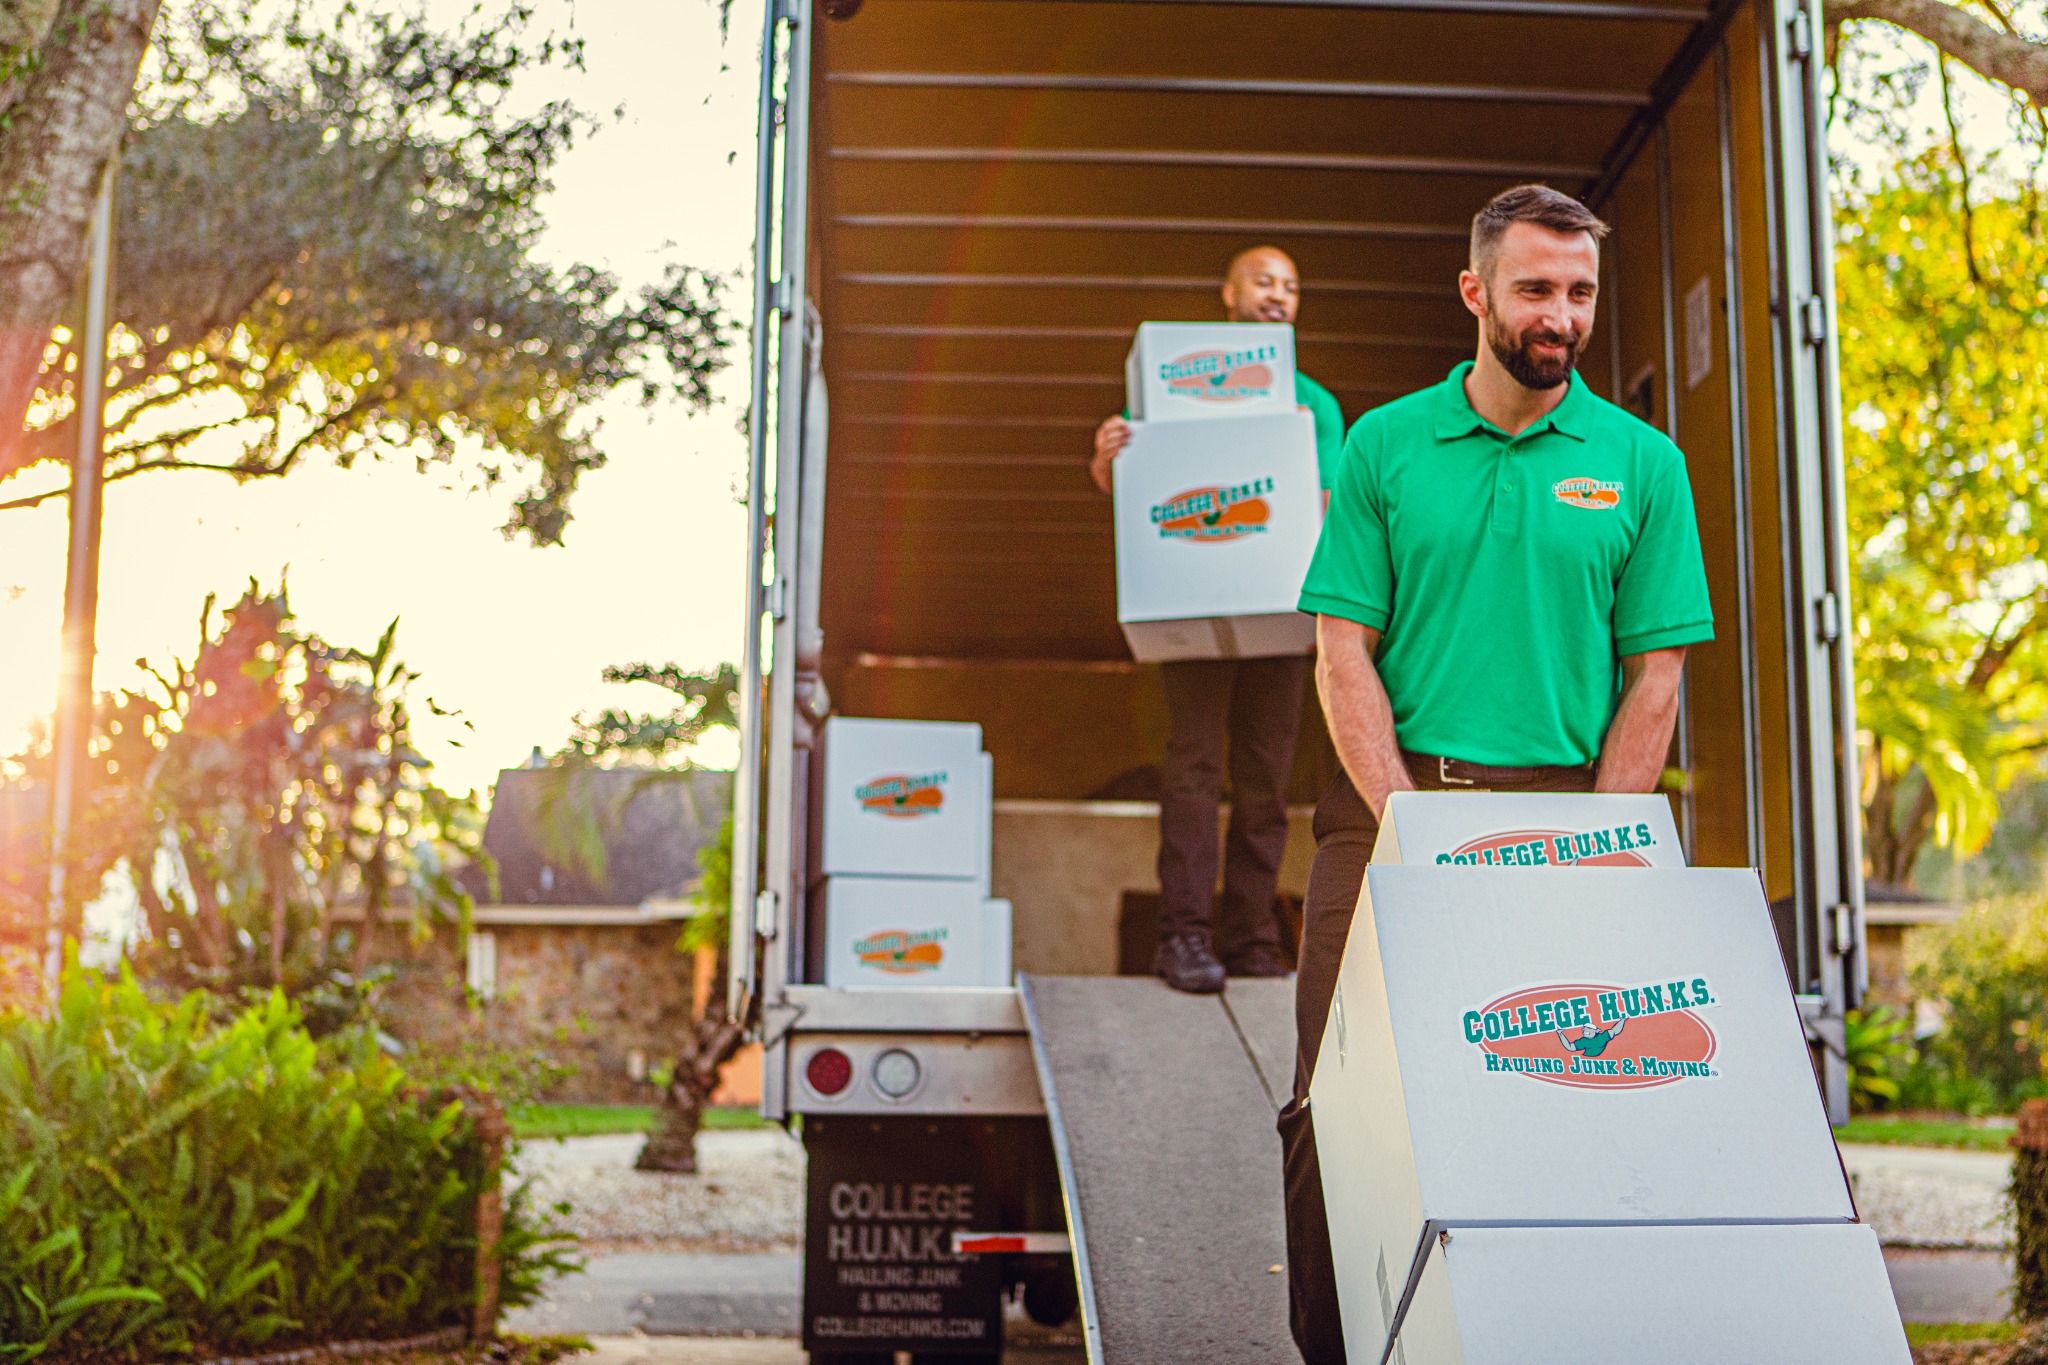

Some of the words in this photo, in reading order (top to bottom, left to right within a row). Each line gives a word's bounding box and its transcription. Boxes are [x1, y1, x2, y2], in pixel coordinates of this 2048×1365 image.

[1554, 823, 1657, 862] H.U.N.K.S.
[1462, 996, 1591, 1044] COLLEGE
[1599, 978, 1716, 1022] H.U.N.K.S.
[1484, 1053, 1564, 1074] HAULING
[1569, 1056, 1619, 1075] JUNK
[1621, 1058, 1637, 1076] &
[830, 1182, 975, 1220] COLLEGE
